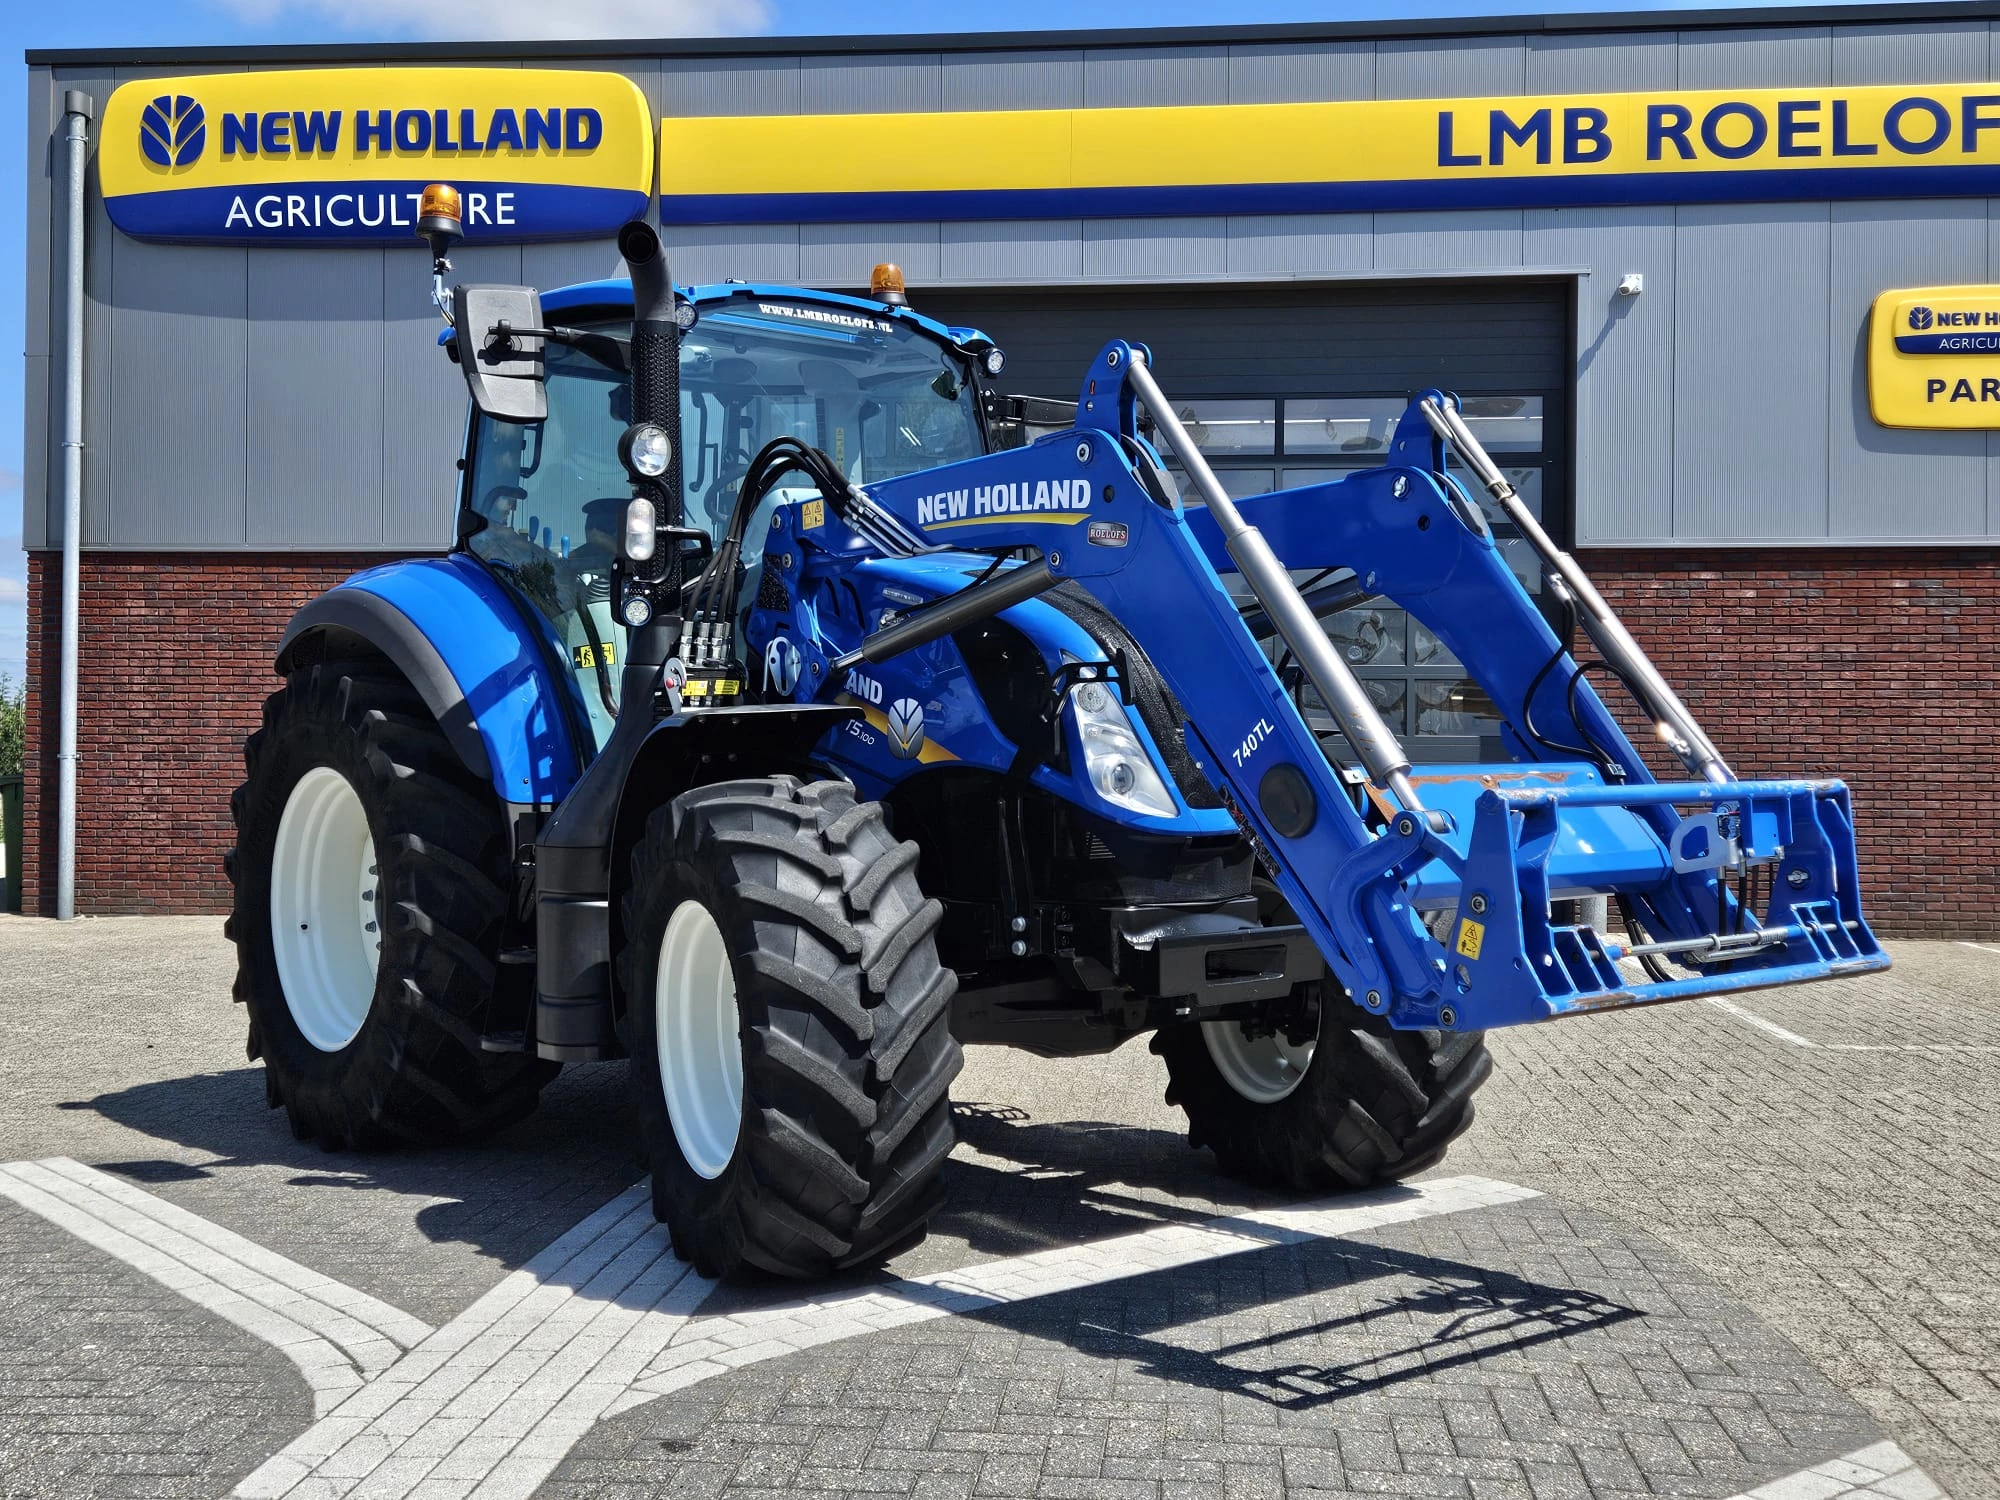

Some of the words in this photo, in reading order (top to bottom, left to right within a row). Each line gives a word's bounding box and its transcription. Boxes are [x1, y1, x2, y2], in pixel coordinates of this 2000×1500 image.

[222, 110, 341, 154] NEW
[355, 107, 602, 152] HOLLAND
[1438, 106, 1612, 167] LMB
[1646, 96, 2000, 160] ROELOF
[224, 192, 516, 228] AGRICULTRE
[1937, 311, 1981, 326] NEW
[1985, 311, 2000, 326] H
[1938, 337, 2000, 349] AGRICU
[1927, 378, 2000, 402] PAR
[917, 489, 969, 525] NEW
[974, 479, 1091, 515] HOLLAND
[1090, 528, 1126, 539] ROELOFS
[844, 670, 883, 704] AND
[1232, 718, 1275, 768] 740TL
